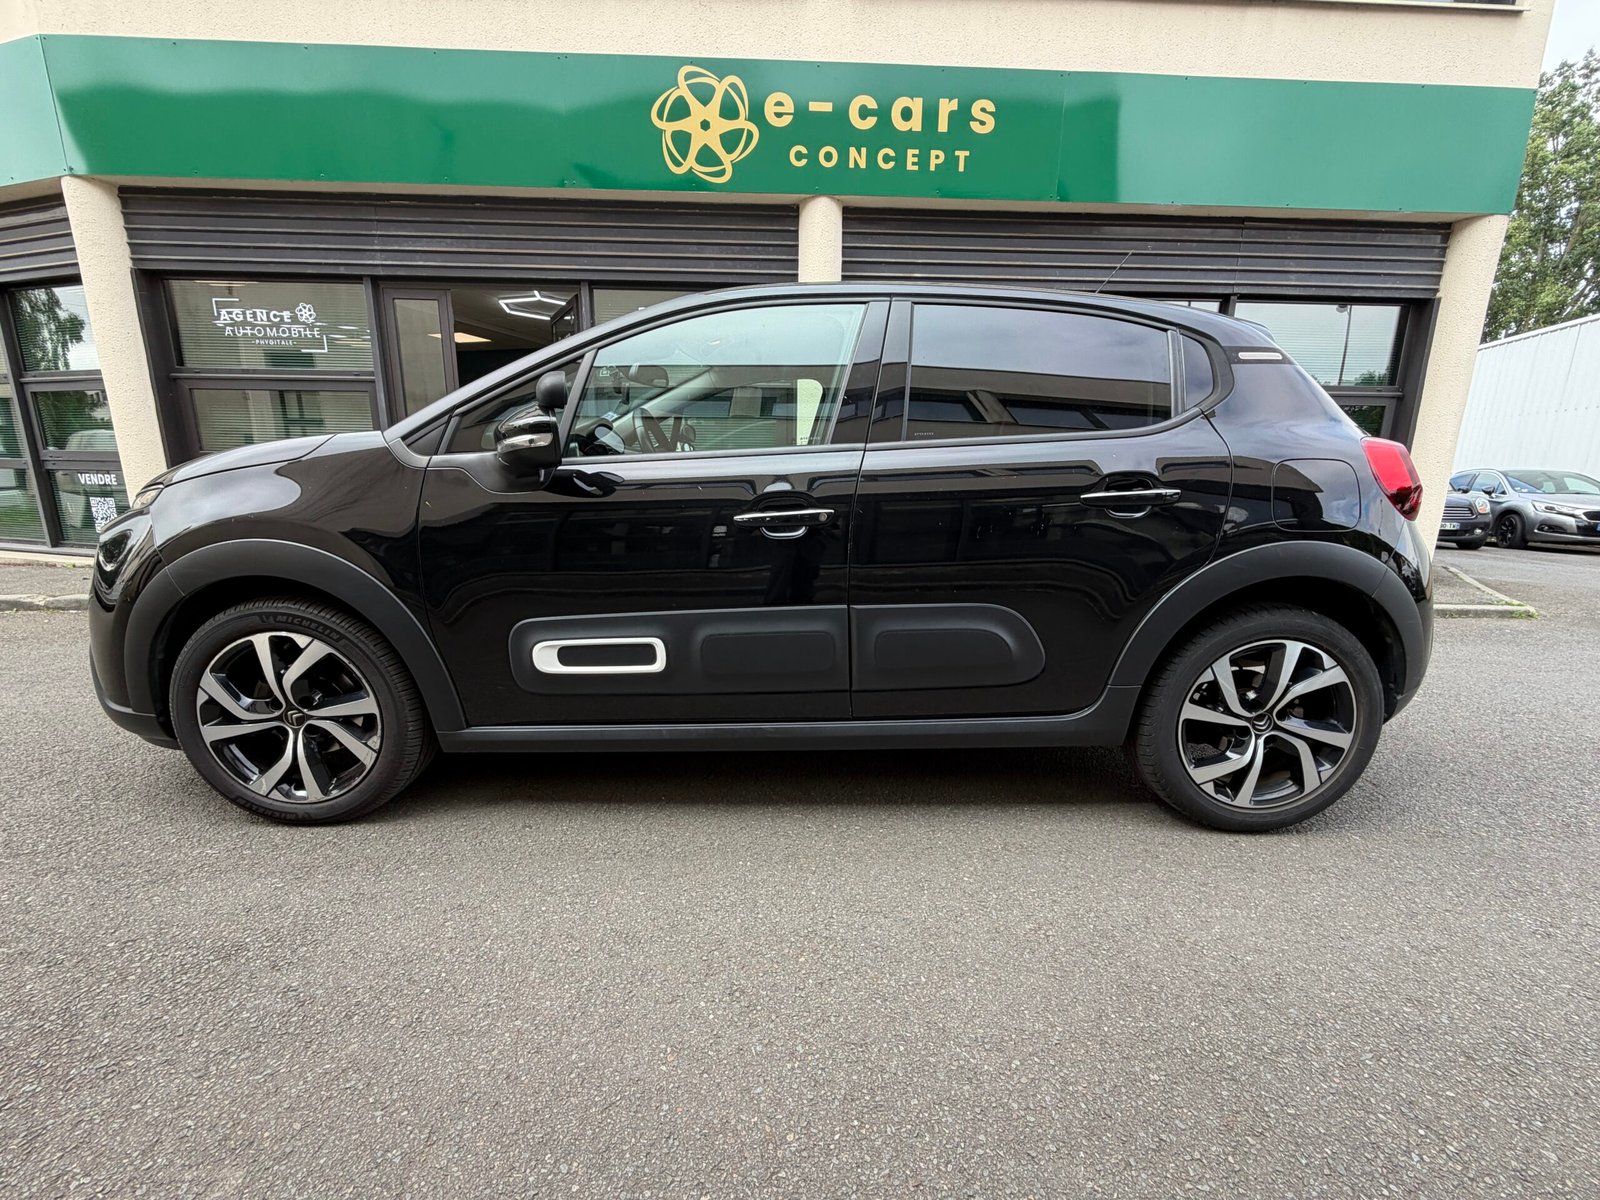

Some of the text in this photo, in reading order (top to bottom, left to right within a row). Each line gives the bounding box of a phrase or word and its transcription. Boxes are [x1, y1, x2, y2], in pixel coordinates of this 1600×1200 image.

[763, 91, 996, 134] e-cars
[789, 145, 970, 172] CONCEPT
[220, 310, 292, 322] AGENCE
[224, 327, 321, 338] AUTOMOBILE
[78, 473, 118, 485] VENDRE
[275, 615, 340, 640] MICHELIN
